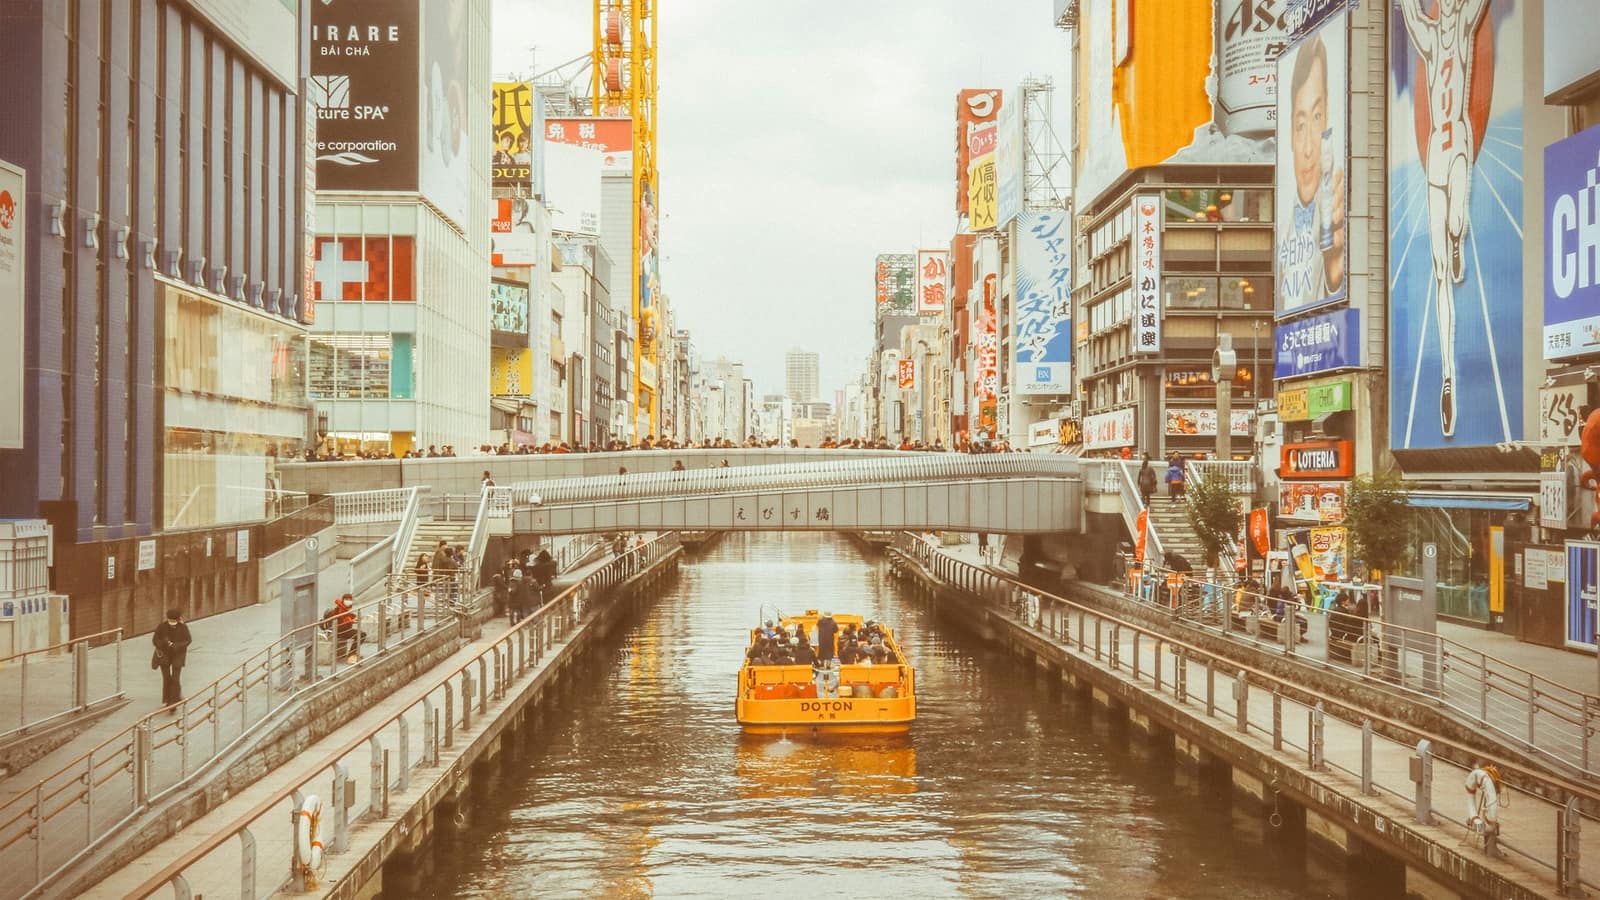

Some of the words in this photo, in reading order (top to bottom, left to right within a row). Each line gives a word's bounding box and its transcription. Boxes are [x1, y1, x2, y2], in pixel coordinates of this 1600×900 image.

[317, 108, 350, 119] ture
[328, 140, 397, 152] corporation
[983, 162, 995, 225] 高収入
[1297, 449, 1335, 469] LOTTERIA
[736, 507, 830, 520] えびす橋
[800, 701, 852, 711] DOTON
